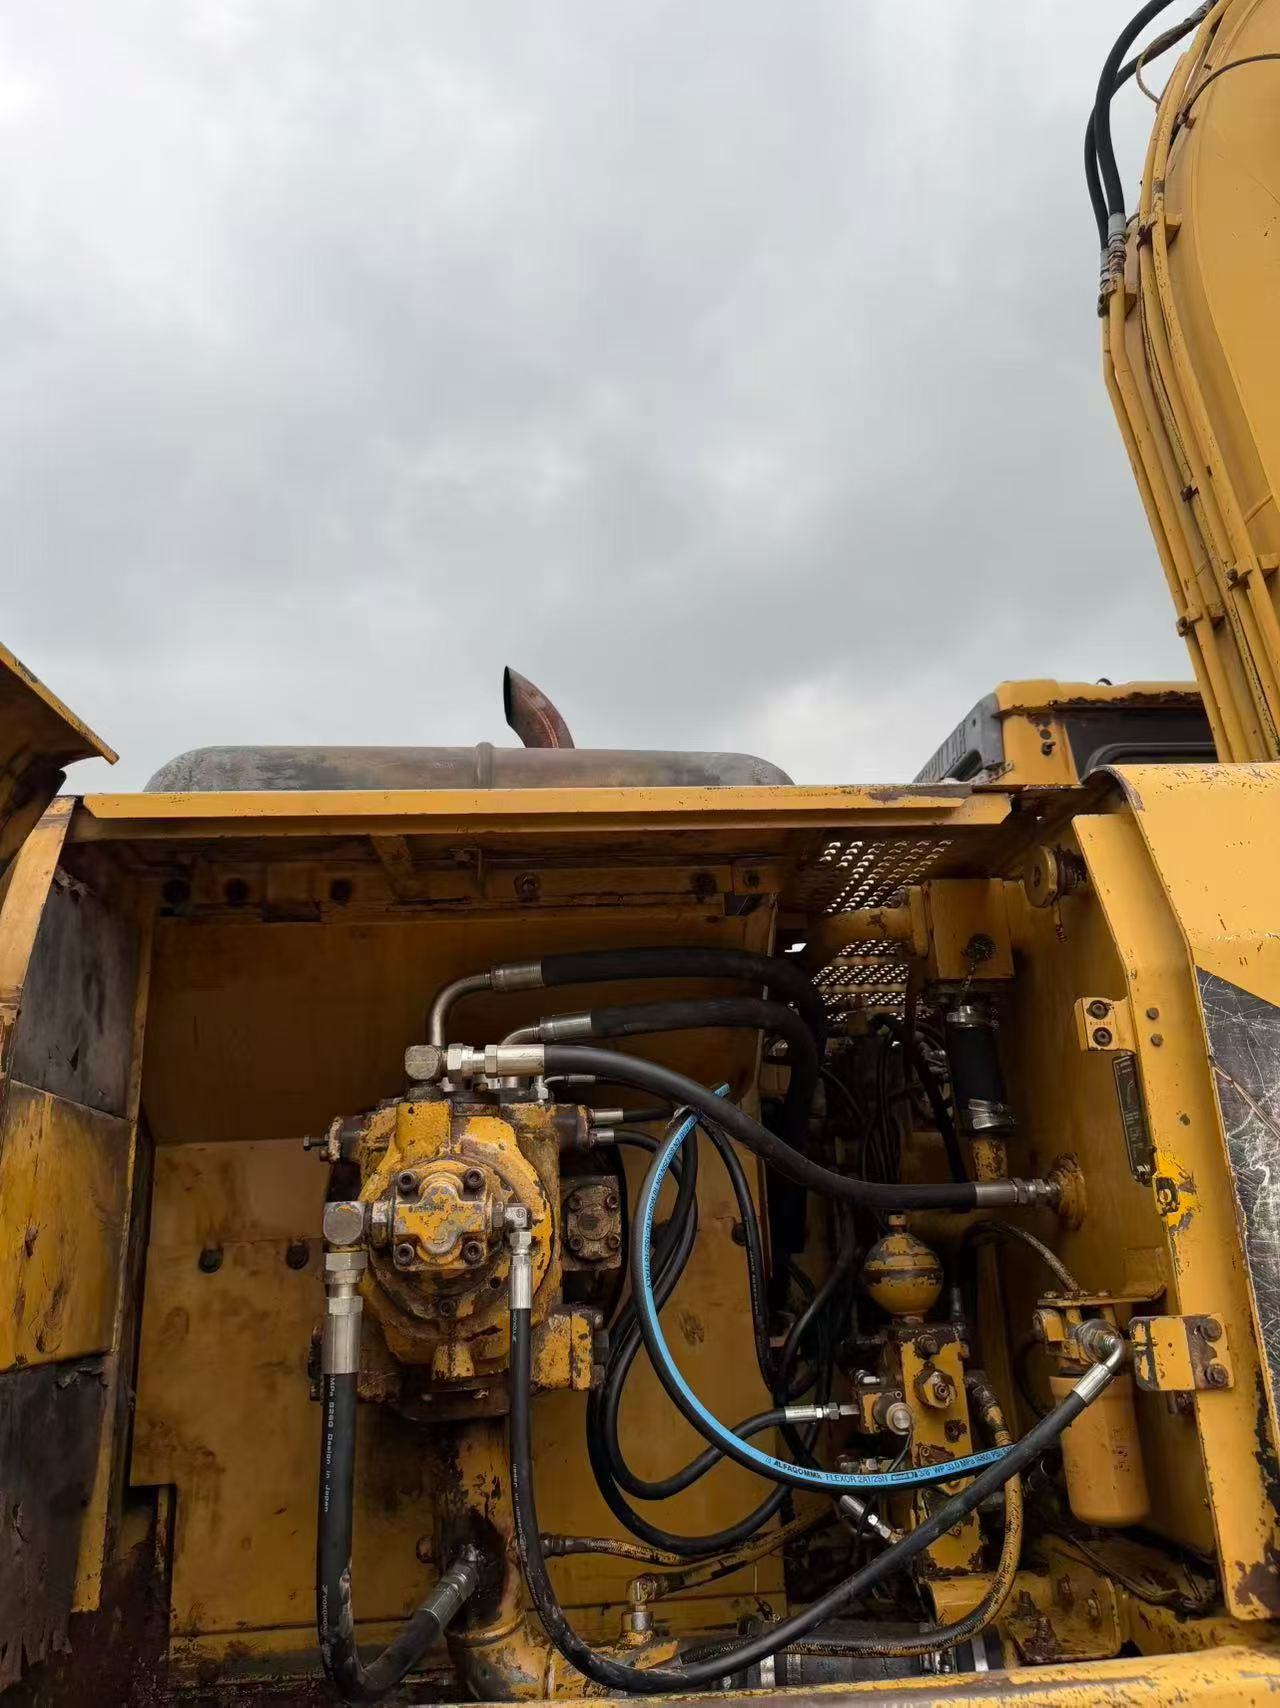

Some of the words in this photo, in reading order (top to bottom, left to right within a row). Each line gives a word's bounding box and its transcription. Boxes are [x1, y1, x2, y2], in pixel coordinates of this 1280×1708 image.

[646, 1195, 657, 1221] MSHA
[643, 1264, 652, 1289] ITALY
[325, 1433, 333, 1465] Design
[825, 1474, 857, 1484] FLEXOR
[932, 1465, 945, 1474] WP
[960, 1457, 975, 1467] MPa
[323, 1484, 331, 1513] Japan
